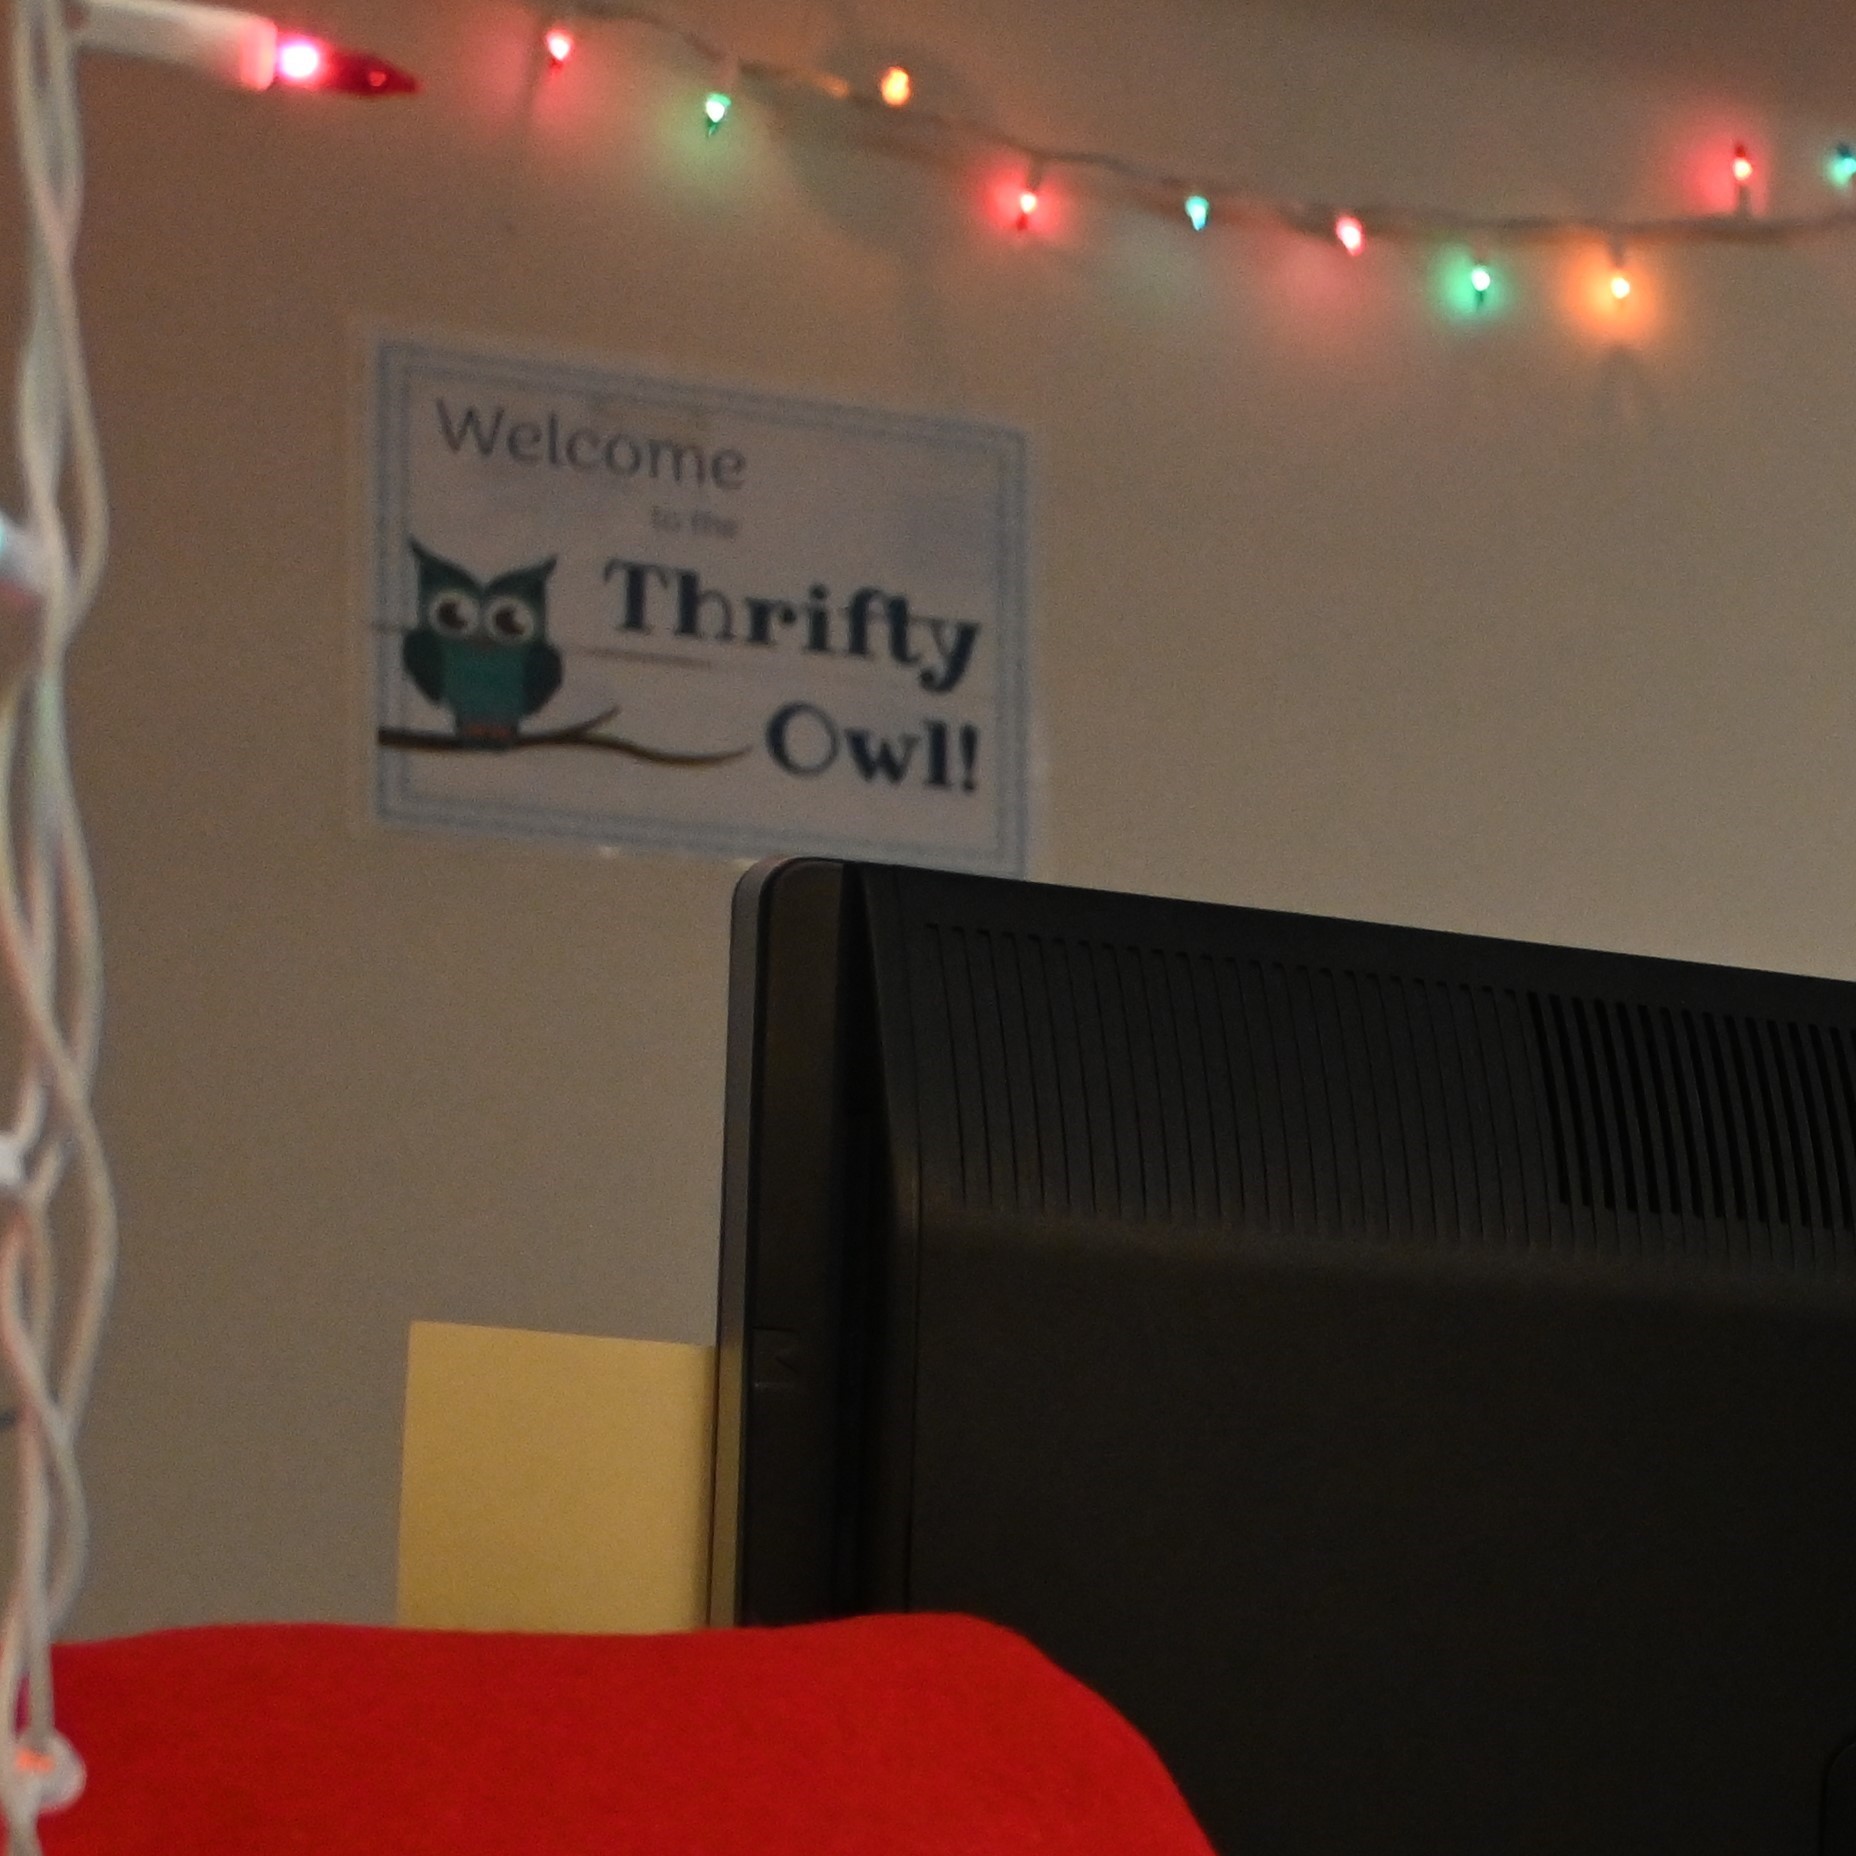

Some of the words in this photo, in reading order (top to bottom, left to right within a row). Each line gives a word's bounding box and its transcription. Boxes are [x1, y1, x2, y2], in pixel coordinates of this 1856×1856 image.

[437, 399, 747, 490] Welcome
[651, 505, 682, 534] to
[690, 508, 738, 538] the
[603, 557, 981, 694] Thrifty
[765, 701, 980, 794] Owl!
